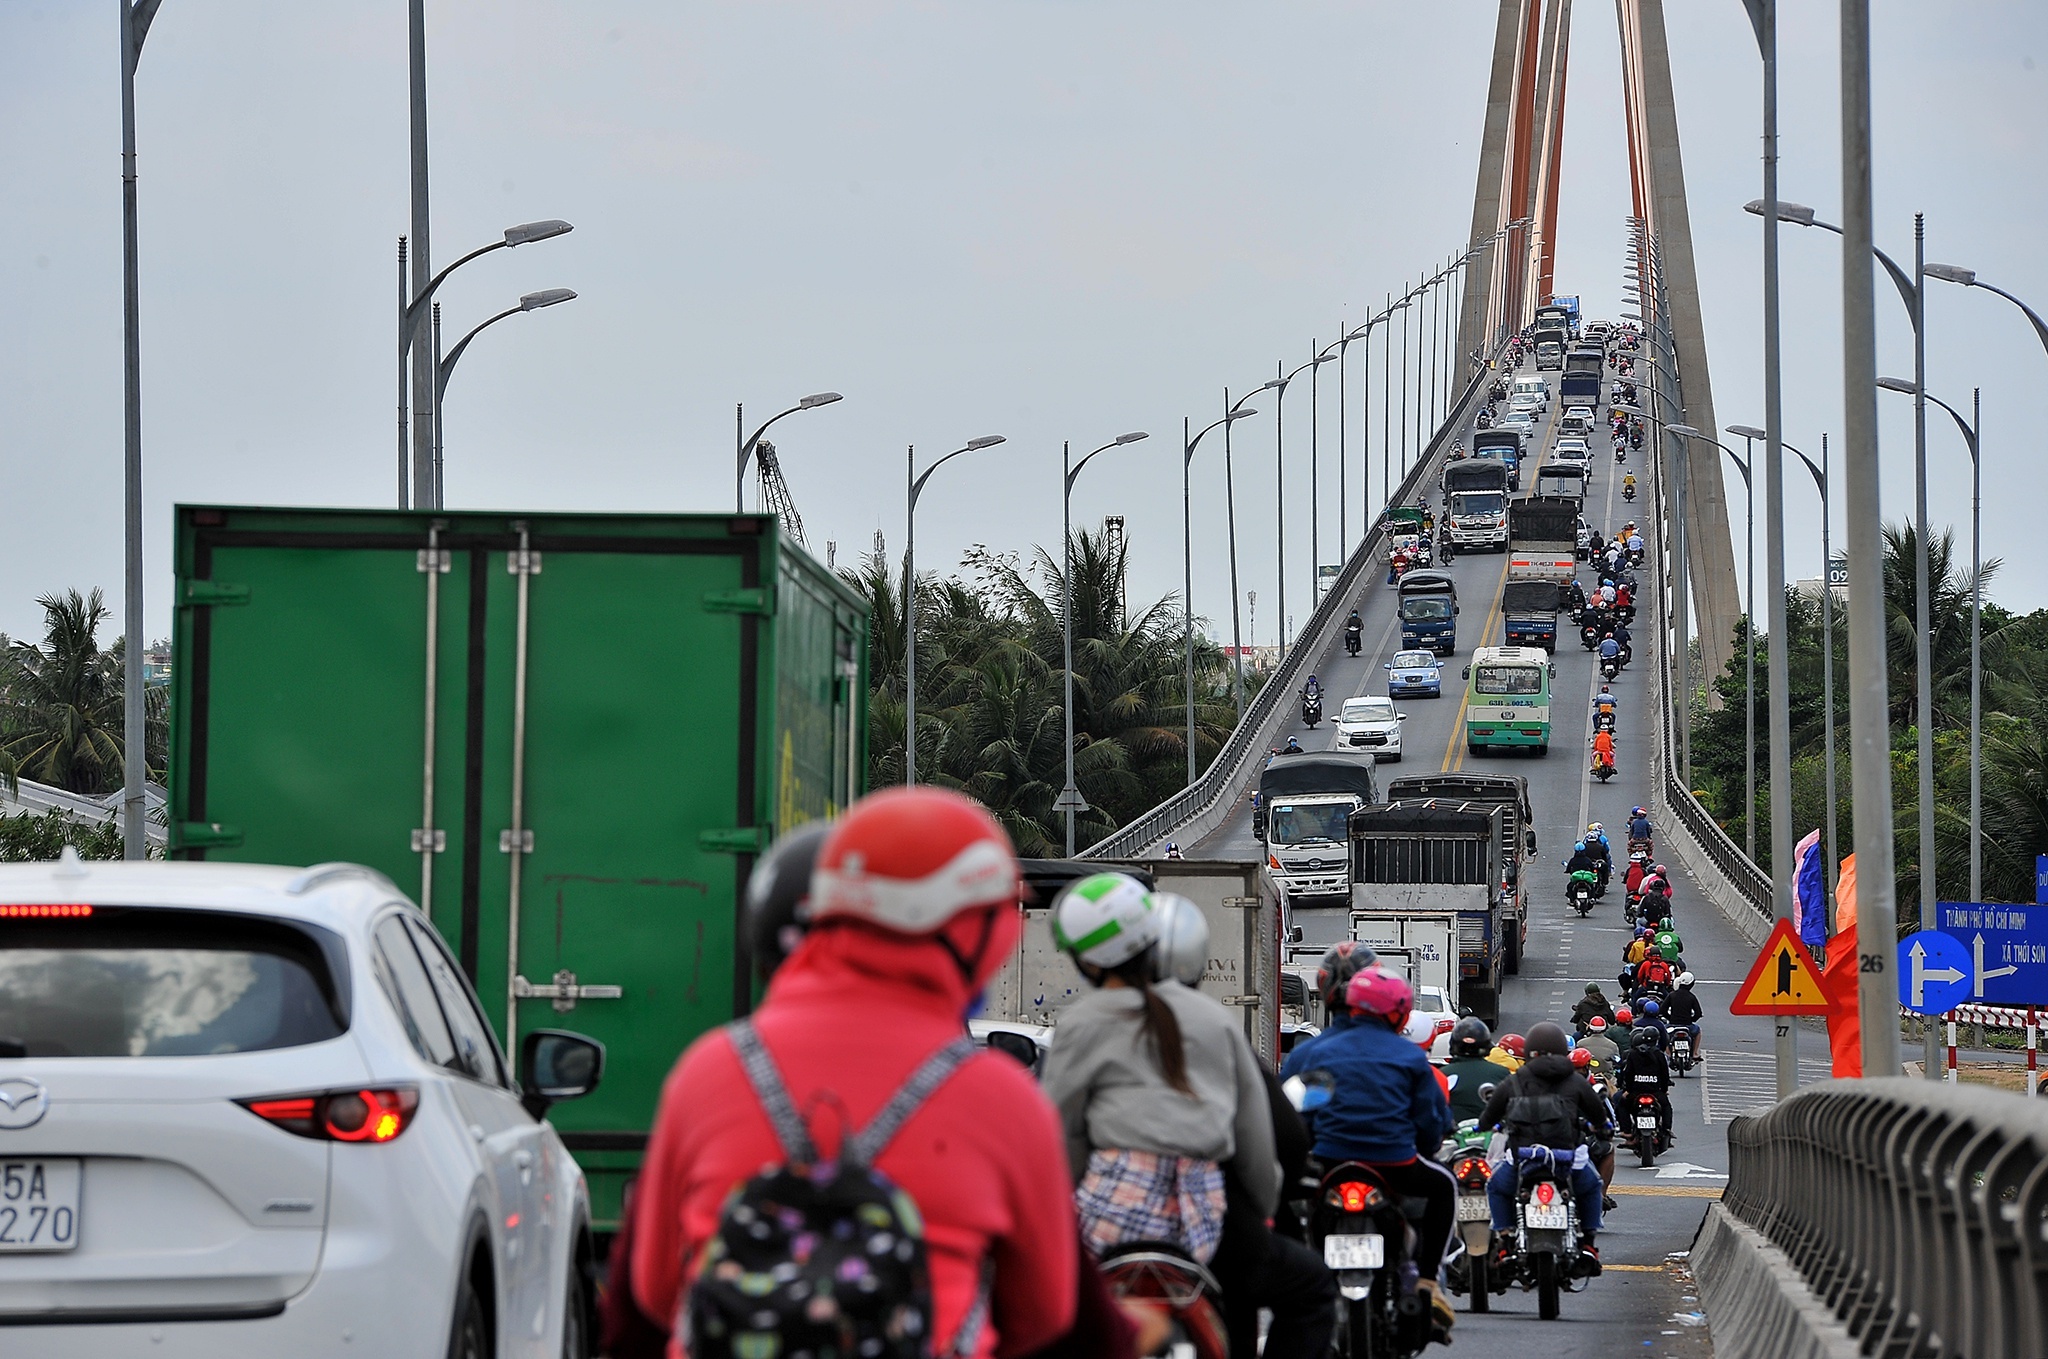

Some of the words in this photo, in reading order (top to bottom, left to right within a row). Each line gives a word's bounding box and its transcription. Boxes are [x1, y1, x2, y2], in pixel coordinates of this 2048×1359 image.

[1830, 570, 1848, 582] 09
[1945, 906, 1968, 928] THÀNH
[1969, 906, 1985, 929] PHỐ
[1985, 905, 1996, 929] HỒ
[1996, 907, 2009, 930] CHÍ
[2009, 912, 2026, 930] MINH
[1422, 944, 1434, 952] 71C
[1207, 959, 1236, 971] IVI
[1860, 954, 1884, 973] 26
[1776, 1025, 1789, 1037] 27
[1634, 1074, 1658, 1083] ADIDAS
[0, 1164, 46, 1200] 5A
[0, 1206, 73, 1242] 2.70
